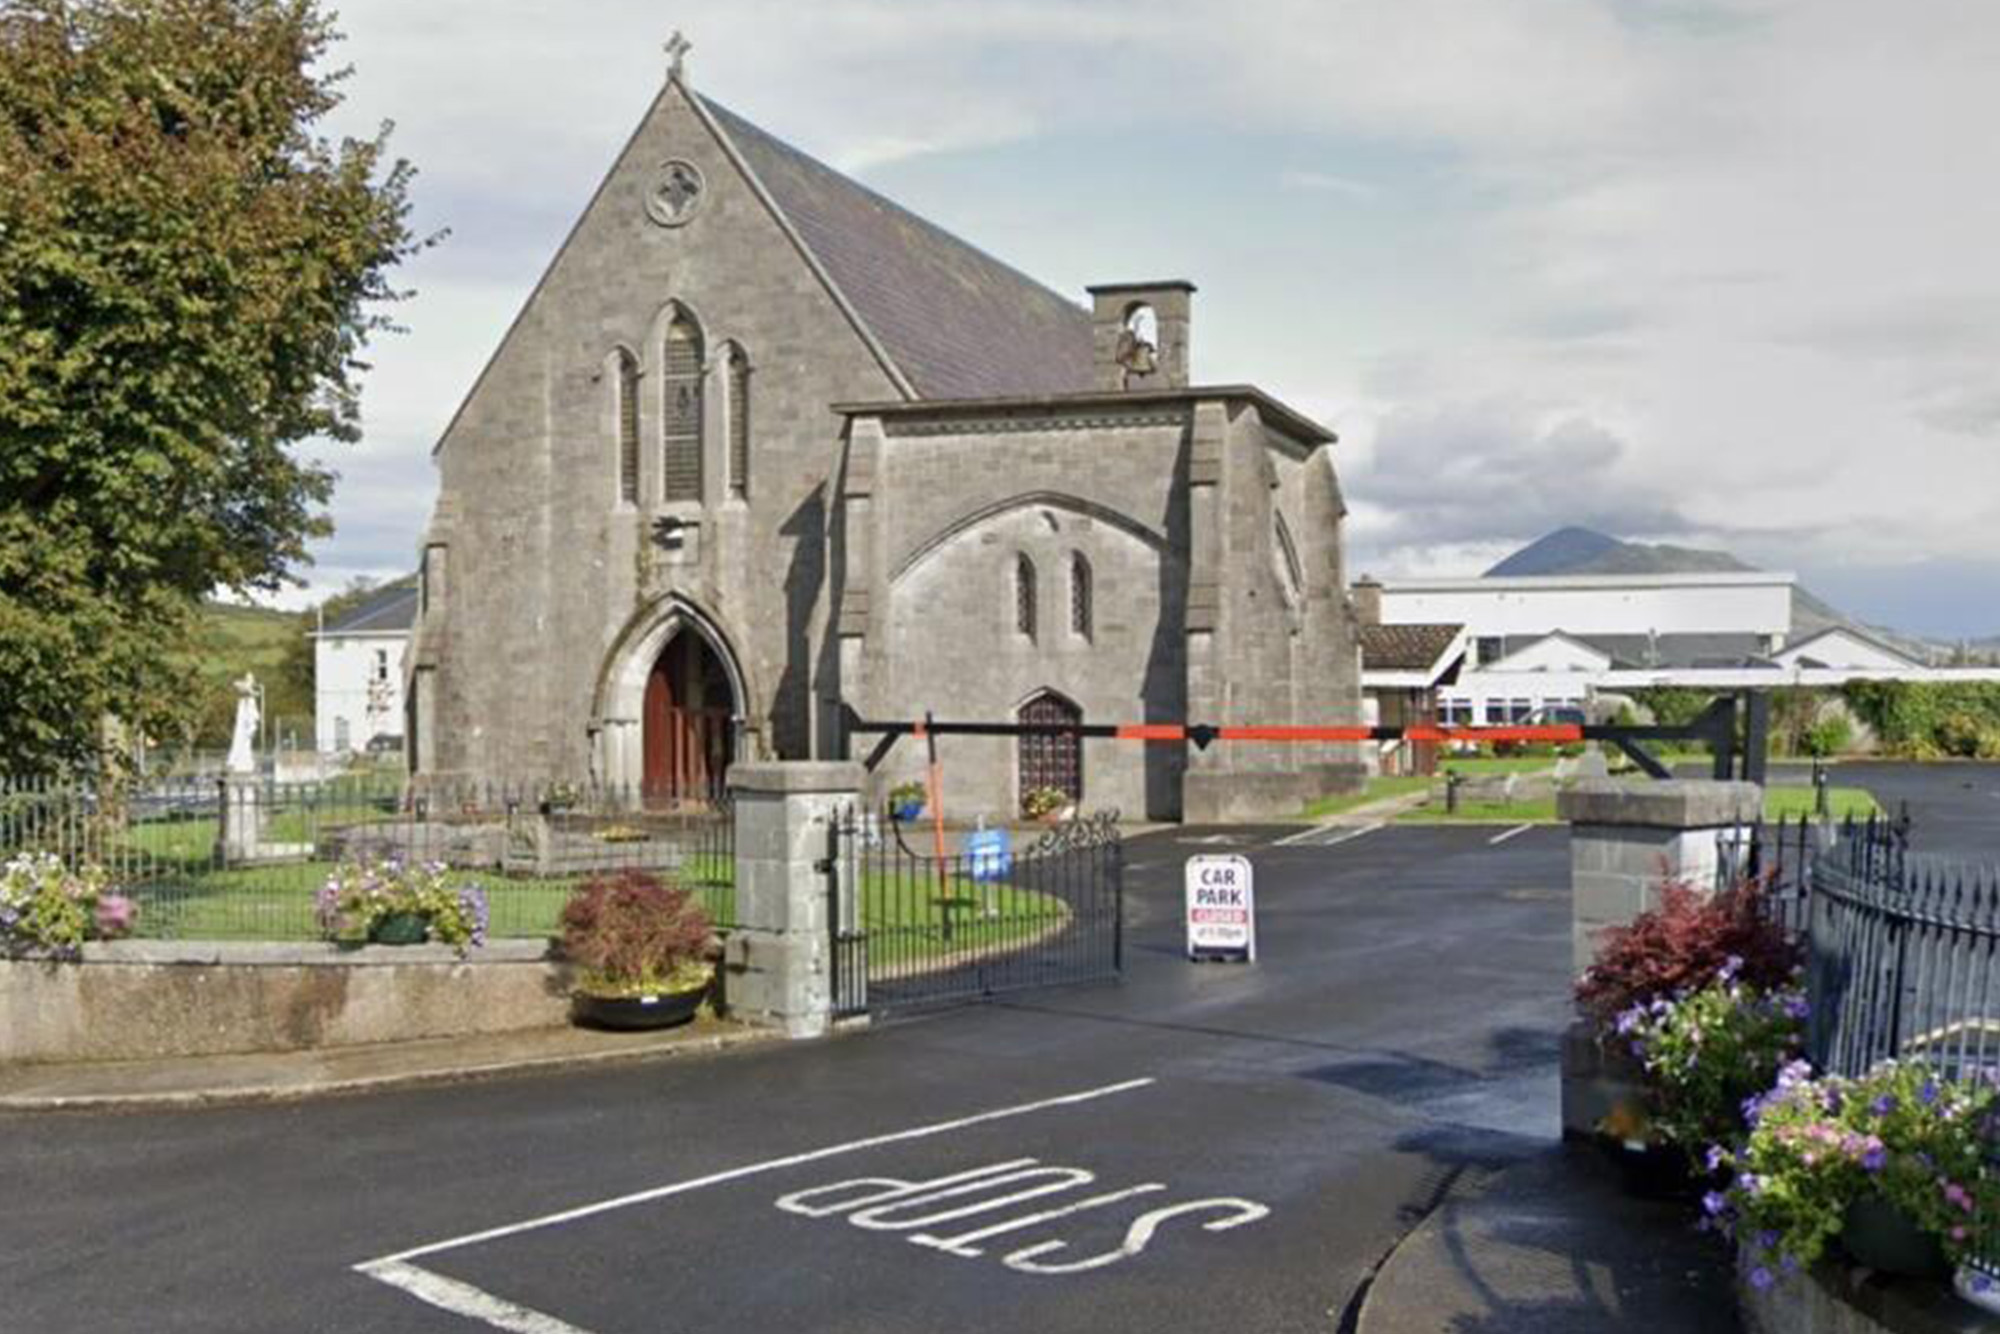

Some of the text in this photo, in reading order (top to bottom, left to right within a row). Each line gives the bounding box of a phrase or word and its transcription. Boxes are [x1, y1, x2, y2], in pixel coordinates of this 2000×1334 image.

[1200, 867, 1236, 886] CAR
[1196, 888, 1242, 906] PARK
[775, 1157, 1270, 1274] STOP
